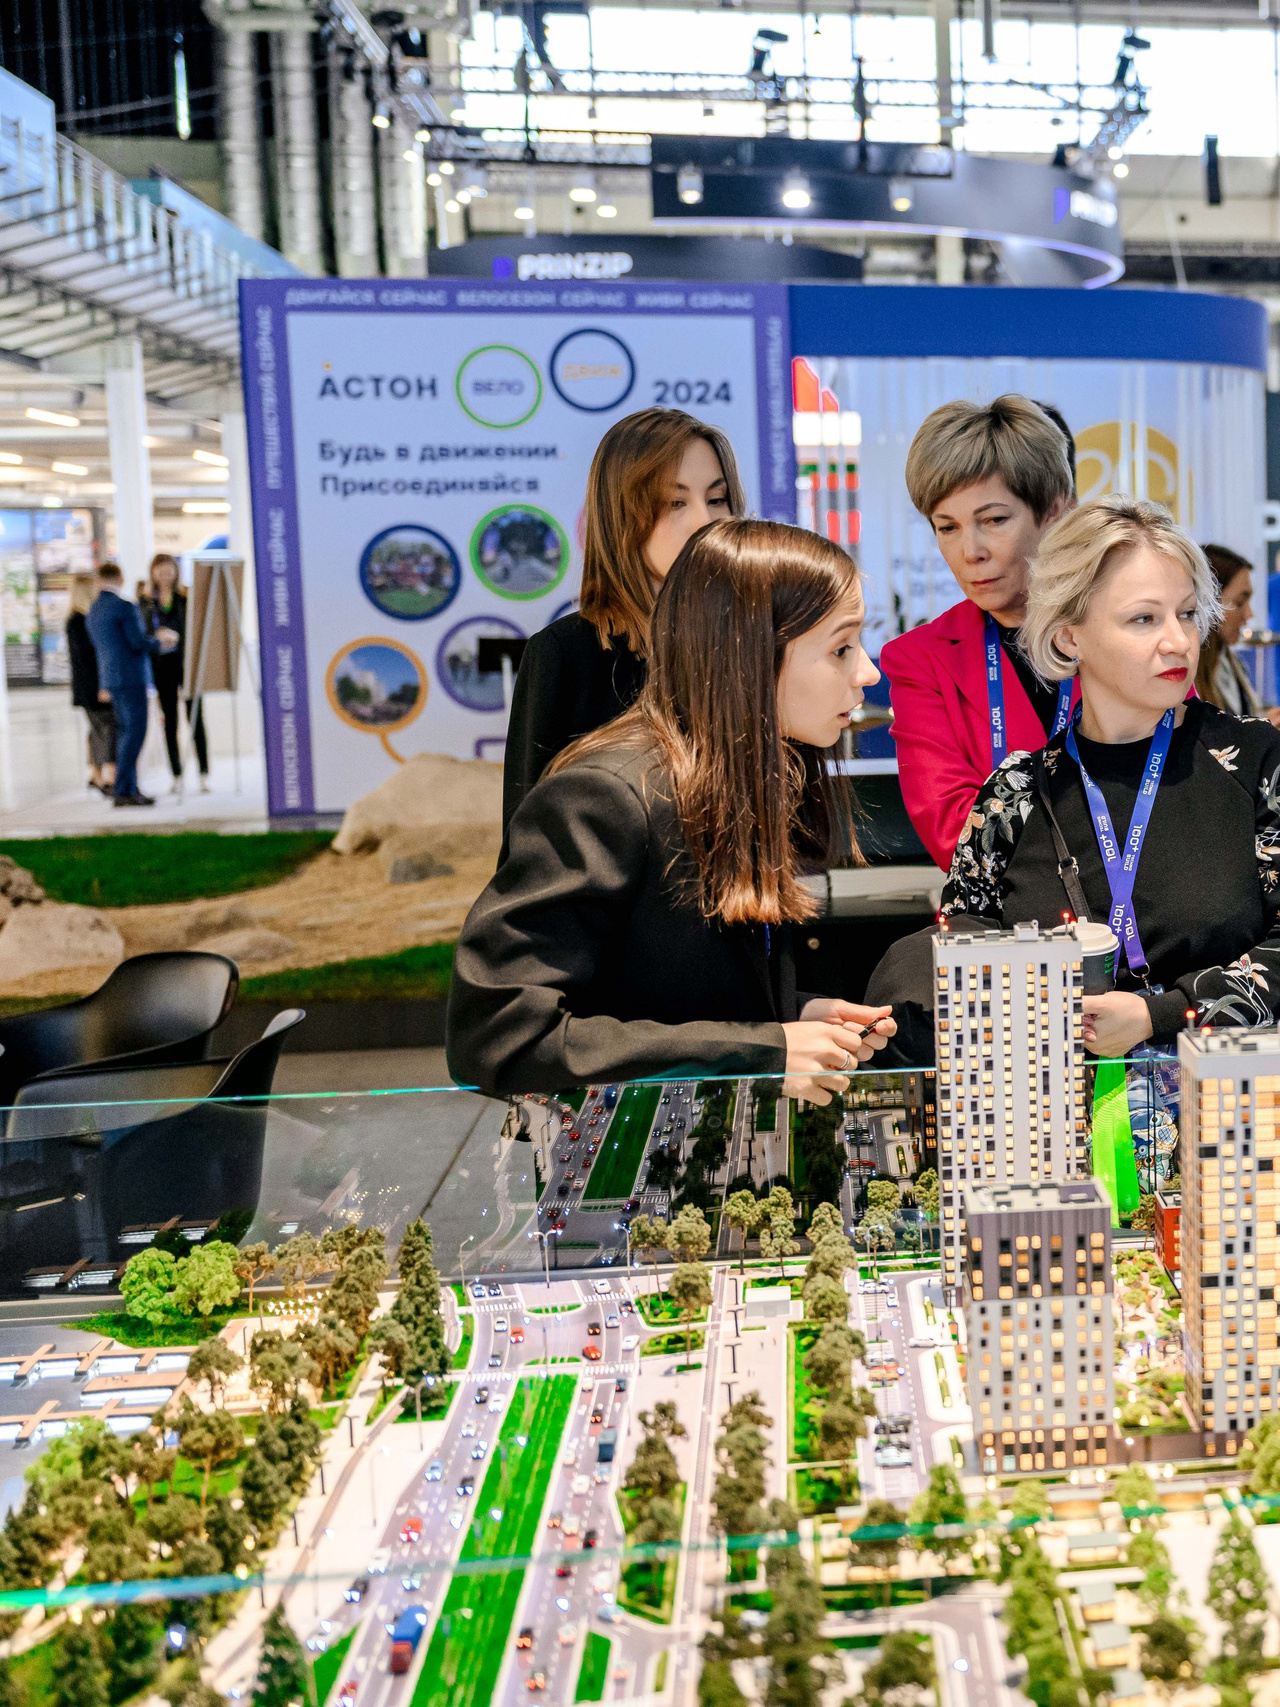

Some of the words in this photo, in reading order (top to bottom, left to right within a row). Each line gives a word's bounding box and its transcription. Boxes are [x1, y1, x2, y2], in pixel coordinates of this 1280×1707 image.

[518, 252, 634, 281] PRINZIP
[378, 287, 447, 306] СЕЙЧАС
[560, 288, 627, 308] СЕЙЧАС
[319, 374, 438, 399] АСТОН
[472, 379, 525, 396] ВЕЛО
[653, 381, 733, 405] 2024
[318, 440, 386, 468] Будь
[396, 445, 410, 461] в
[320, 472, 540, 499] Присоединяйся
[987, 643, 998, 665] 100+
[991, 706, 1003, 731] 100+
[1055, 710, 1067, 735] 00+
[1149, 753, 1162, 779] 100+
[1099, 834, 1117, 862] 100+
[1130, 824, 1143, 853] 100+
[1112, 903, 1126, 934] 100+
